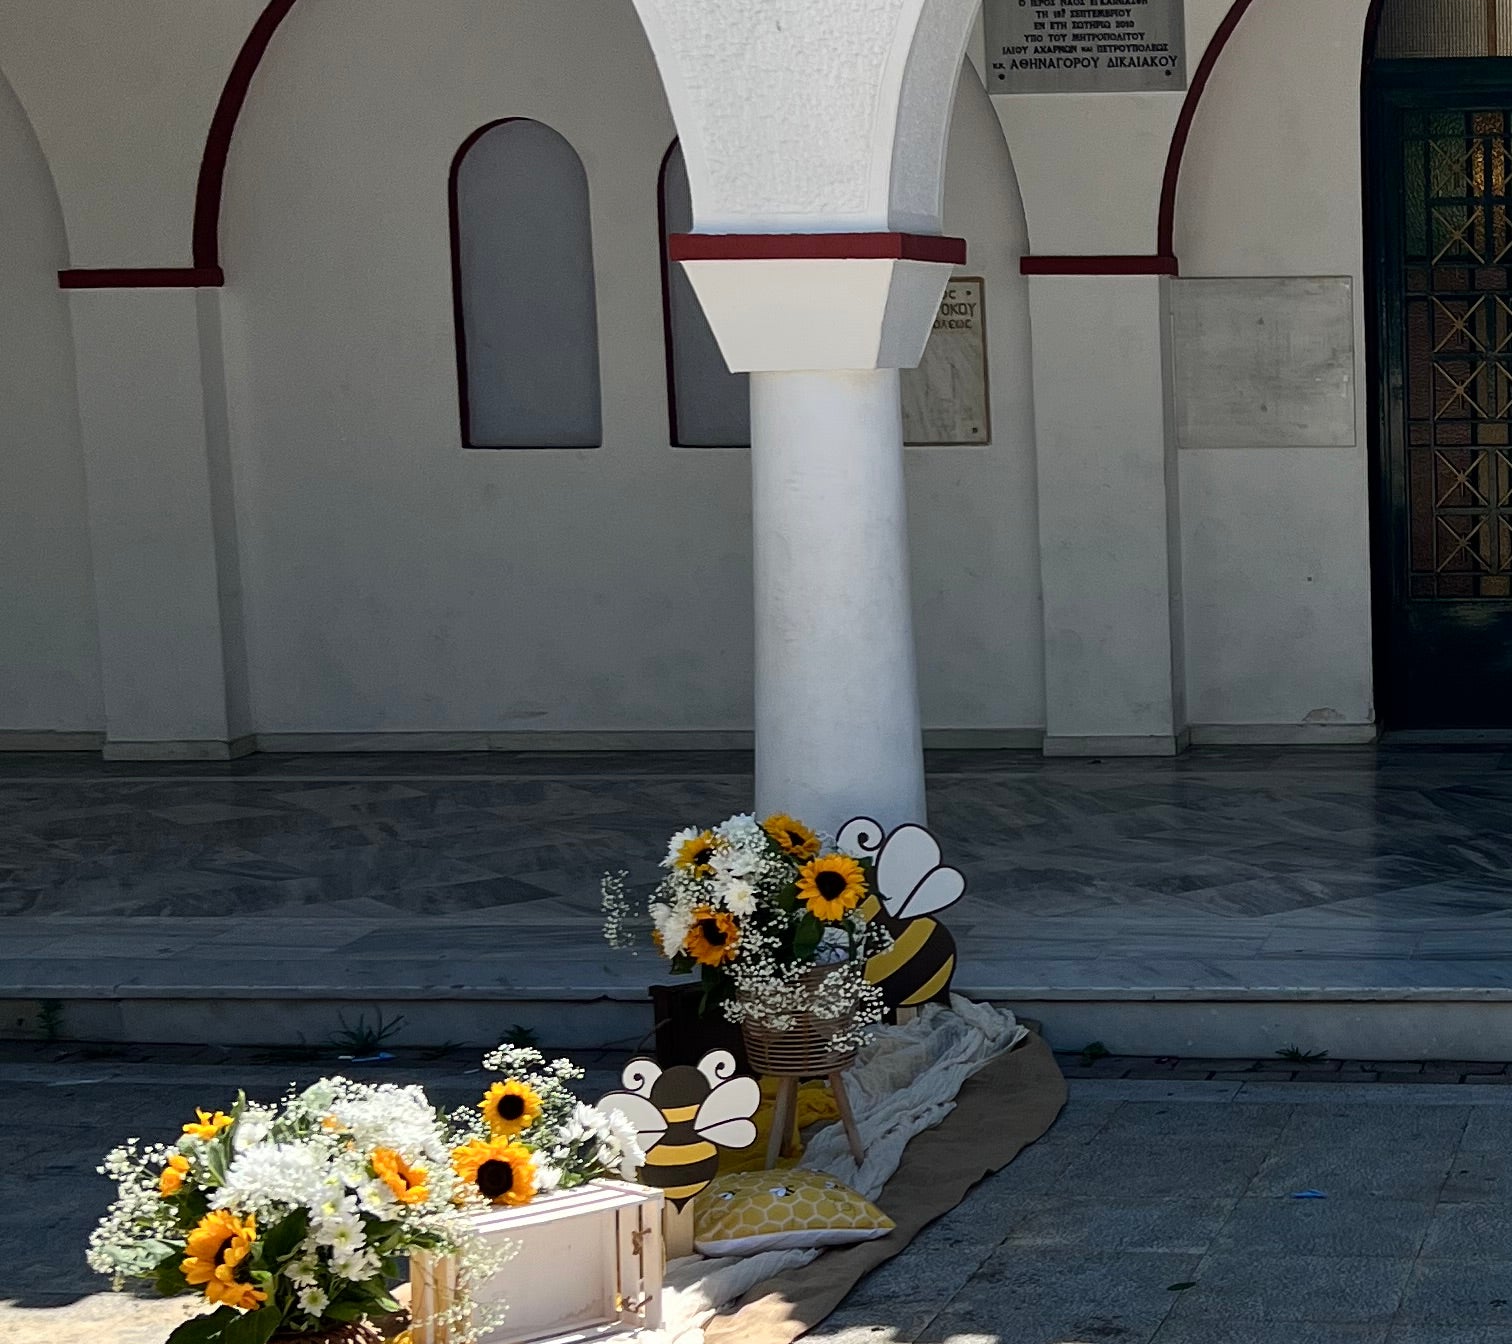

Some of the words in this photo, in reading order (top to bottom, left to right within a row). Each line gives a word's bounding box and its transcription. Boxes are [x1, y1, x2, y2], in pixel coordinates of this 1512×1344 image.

[1049, 34, 1067, 42] ΤΟΥ
[1010, 57, 1100, 70] ΑΘΗΝΑΓΟΡΟΥ
[1107, 55, 1178, 67] ΔΙΚΑΙΑΚΟΥ
